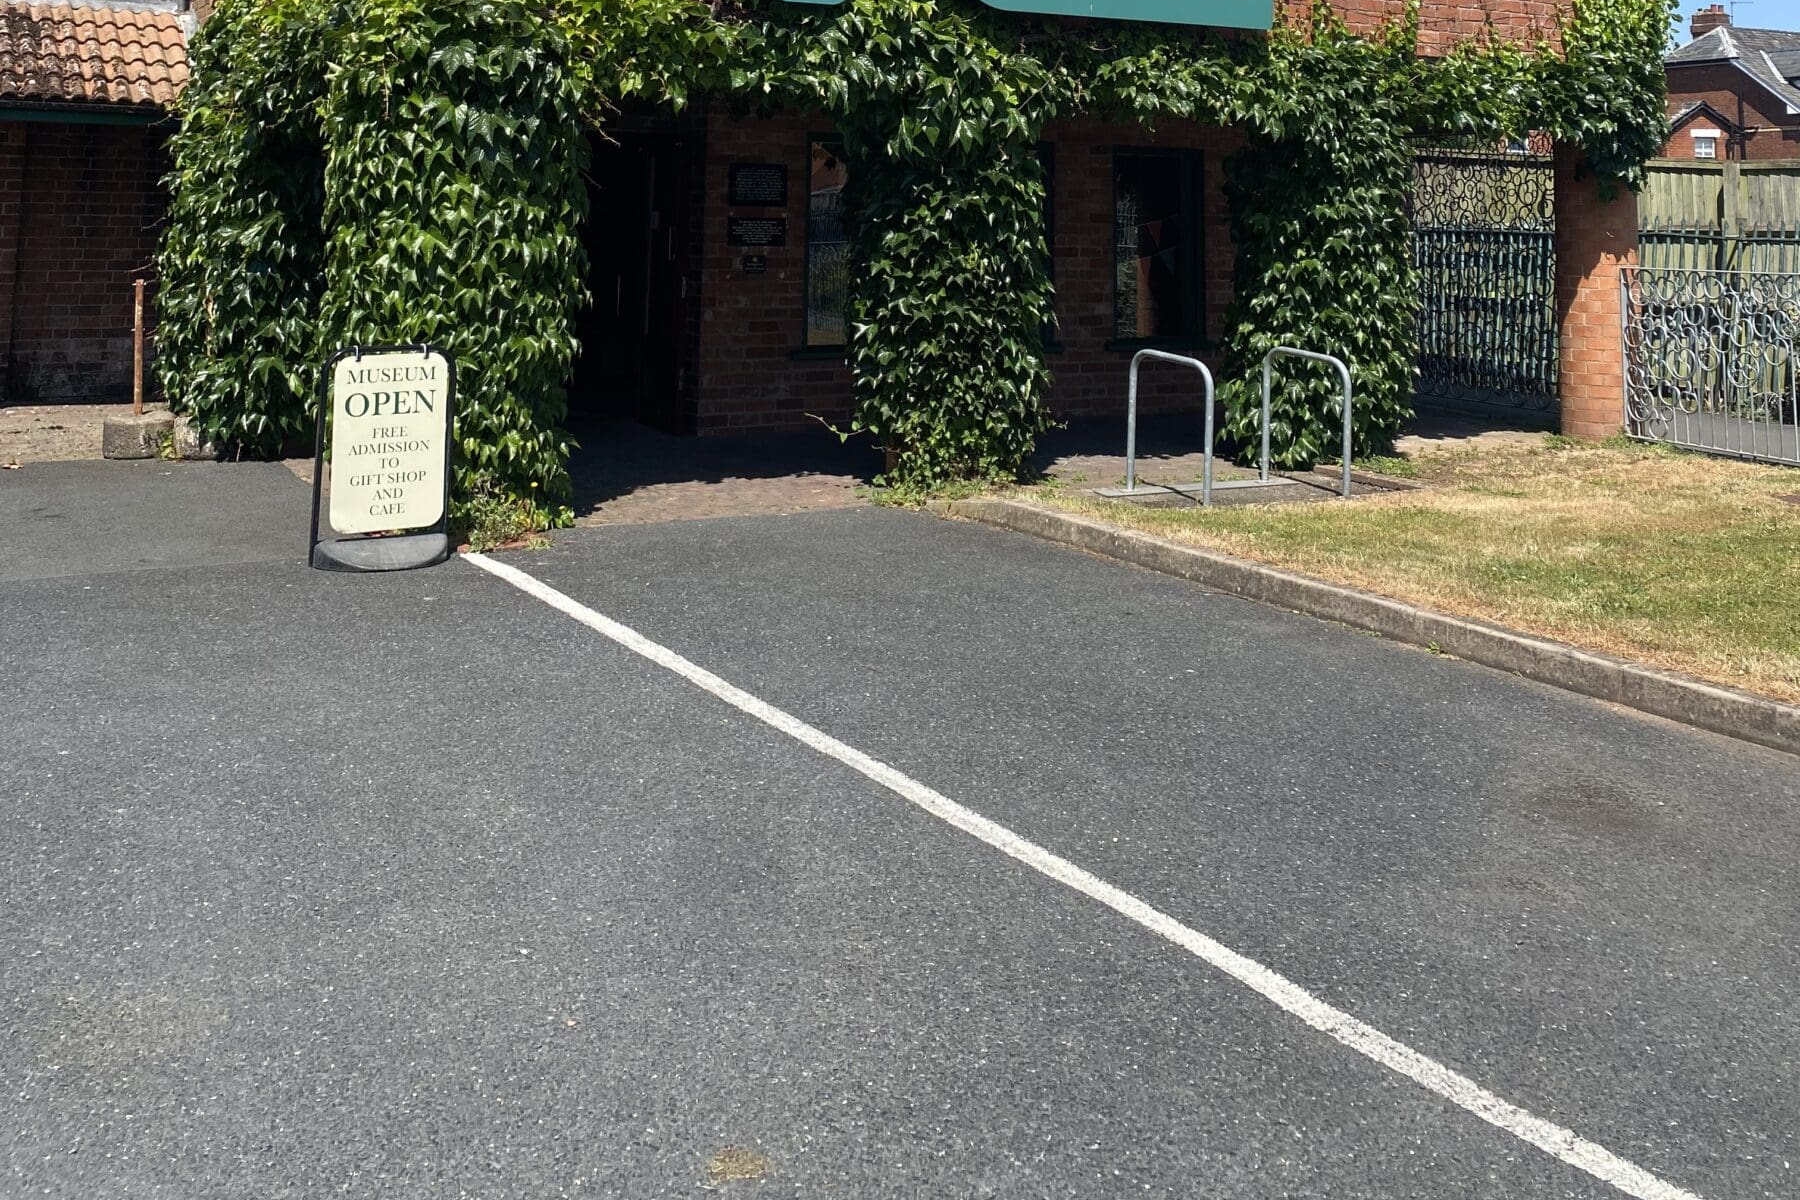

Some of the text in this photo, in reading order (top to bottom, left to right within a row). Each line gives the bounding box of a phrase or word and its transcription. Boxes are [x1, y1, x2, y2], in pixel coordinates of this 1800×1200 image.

[346, 366, 436, 385] MUSEUM
[344, 389, 437, 418] OPEN
[372, 426, 409, 439] FREE
[348, 440, 430, 456] ADMISSION
[378, 457, 400, 469] TO
[350, 470, 427, 487] GIFT SHOP
[373, 488, 403, 500] AND
[369, 503, 405, 516] CAFE
